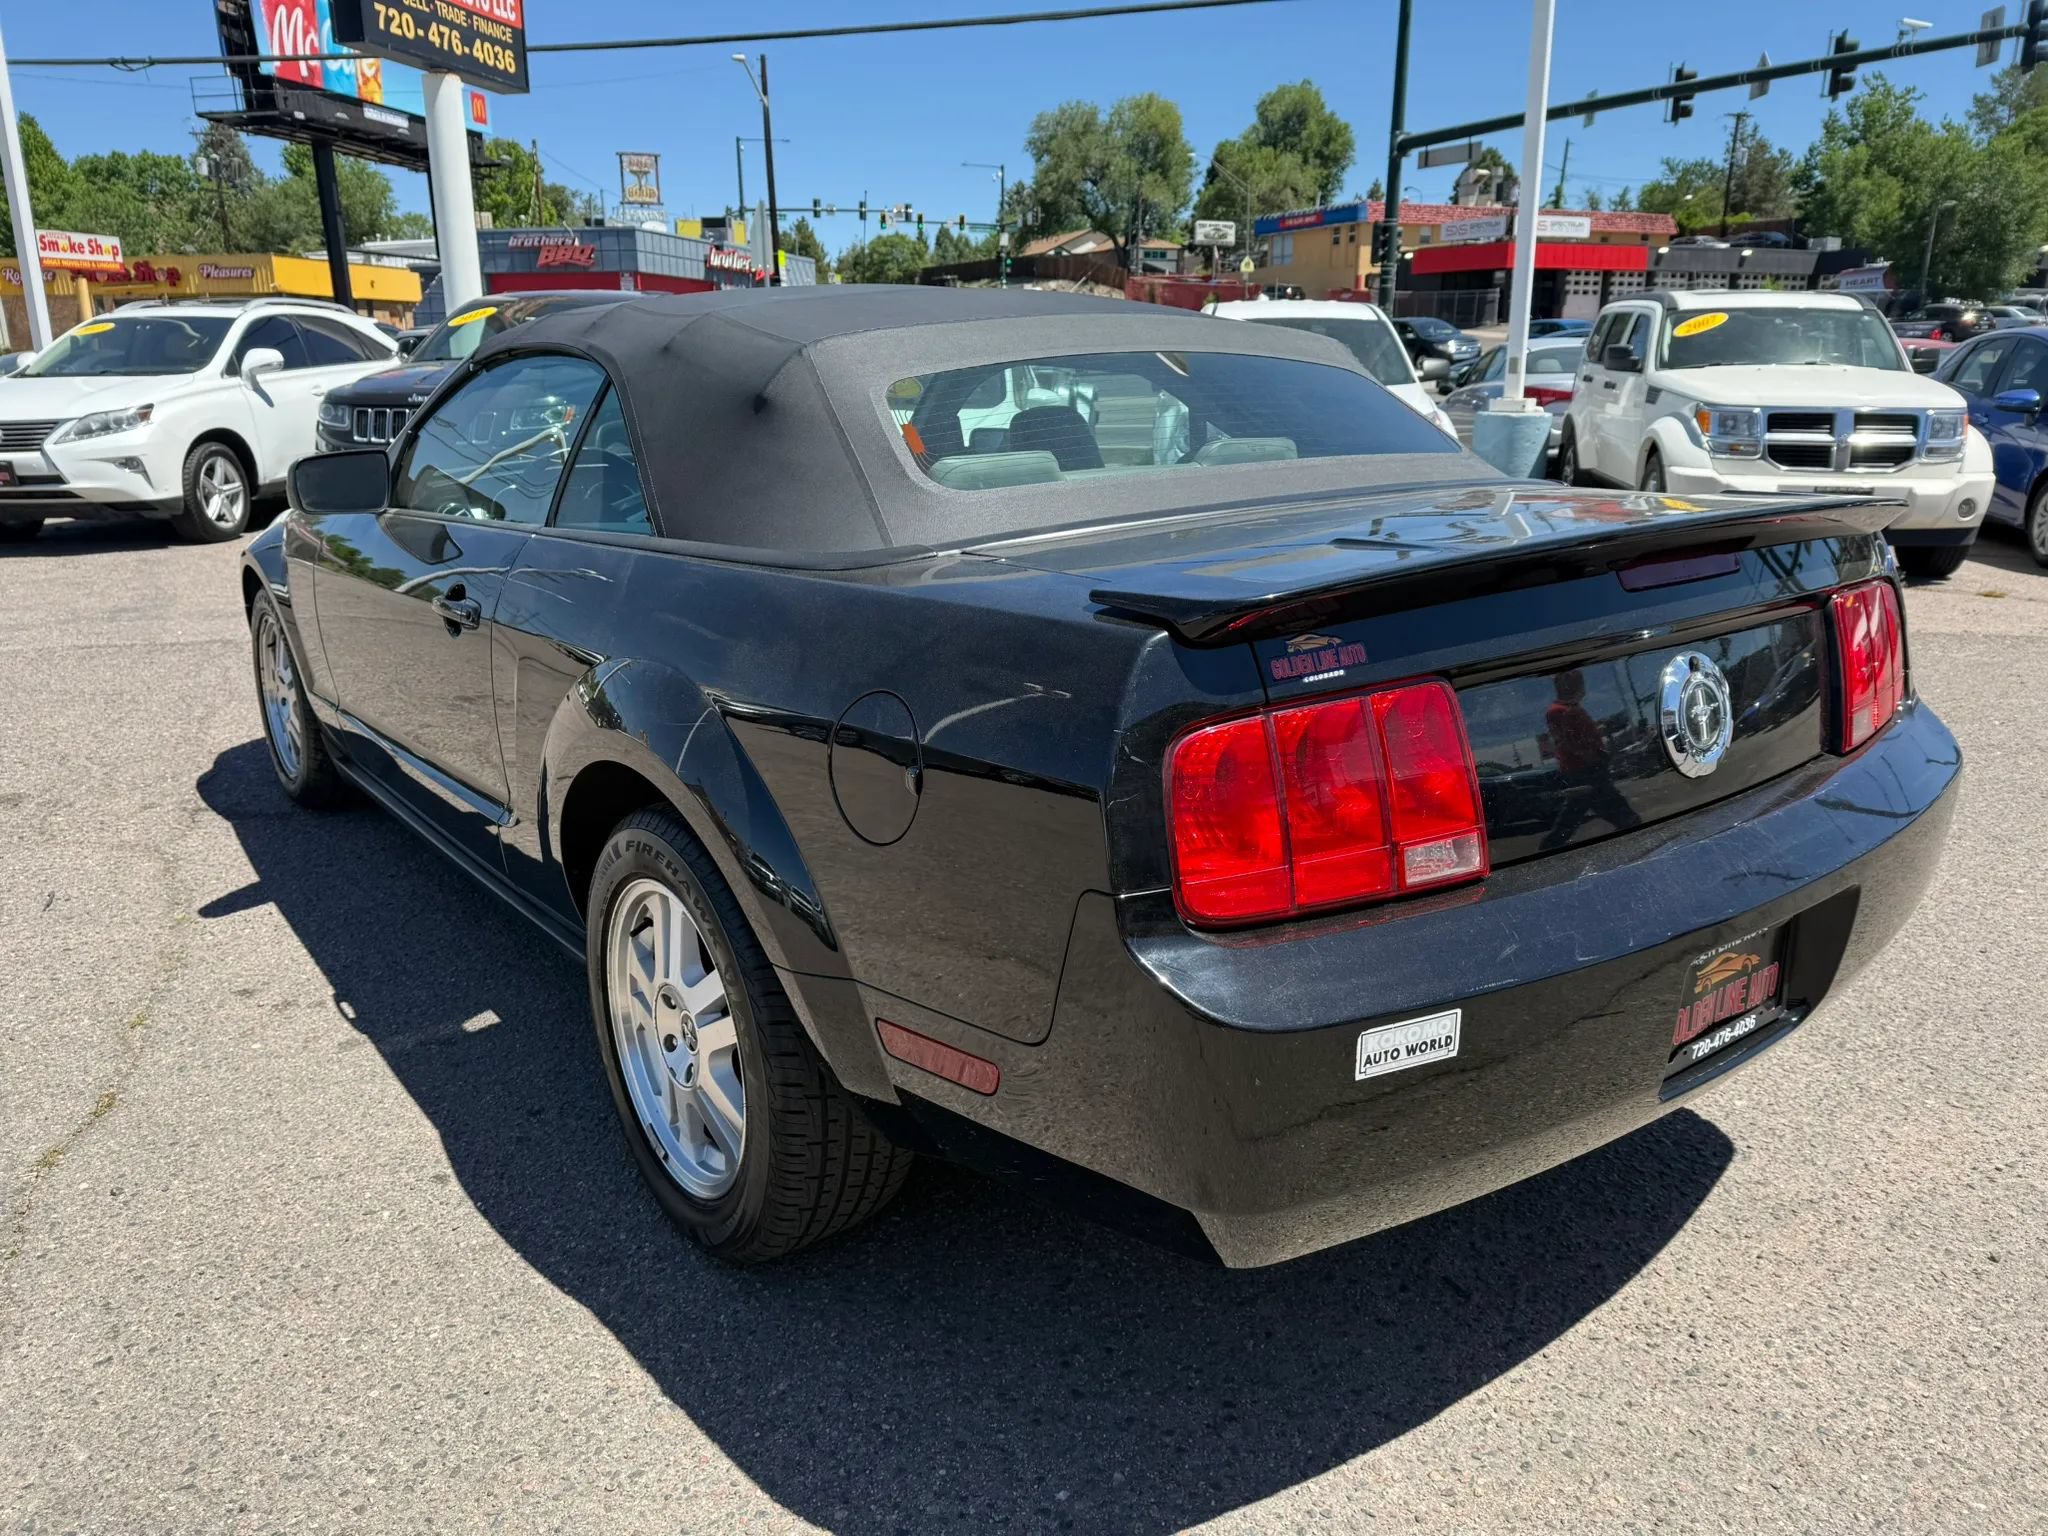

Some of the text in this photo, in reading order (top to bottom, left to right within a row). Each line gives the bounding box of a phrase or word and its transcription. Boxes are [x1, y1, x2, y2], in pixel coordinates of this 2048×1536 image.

[435, 1, 468, 27] TRADE
[472, 15, 513, 43] FINANCE
[373, 3, 516, 74] 720-476-4036
[39, 234, 120, 261] Smoke Shop
[507, 235, 574, 248] brothers
[537, 244, 597, 268] BBQ
[709, 245, 752, 272] brother
[2, 267, 54, 285] Roce
[198, 263, 256, 280] Pleasures
[1845, 276, 1881, 288] HEART
[1270, 642, 1368, 680] GOLDEN LINE AUTO
[1302, 669, 1345, 683] COLORADO
[1672, 960, 1780, 1046] OLDEN LINE AUTO
[1365, 1020, 1452, 1052] KOKOMO
[1363, 1034, 1453, 1068] AUTO WORLD
